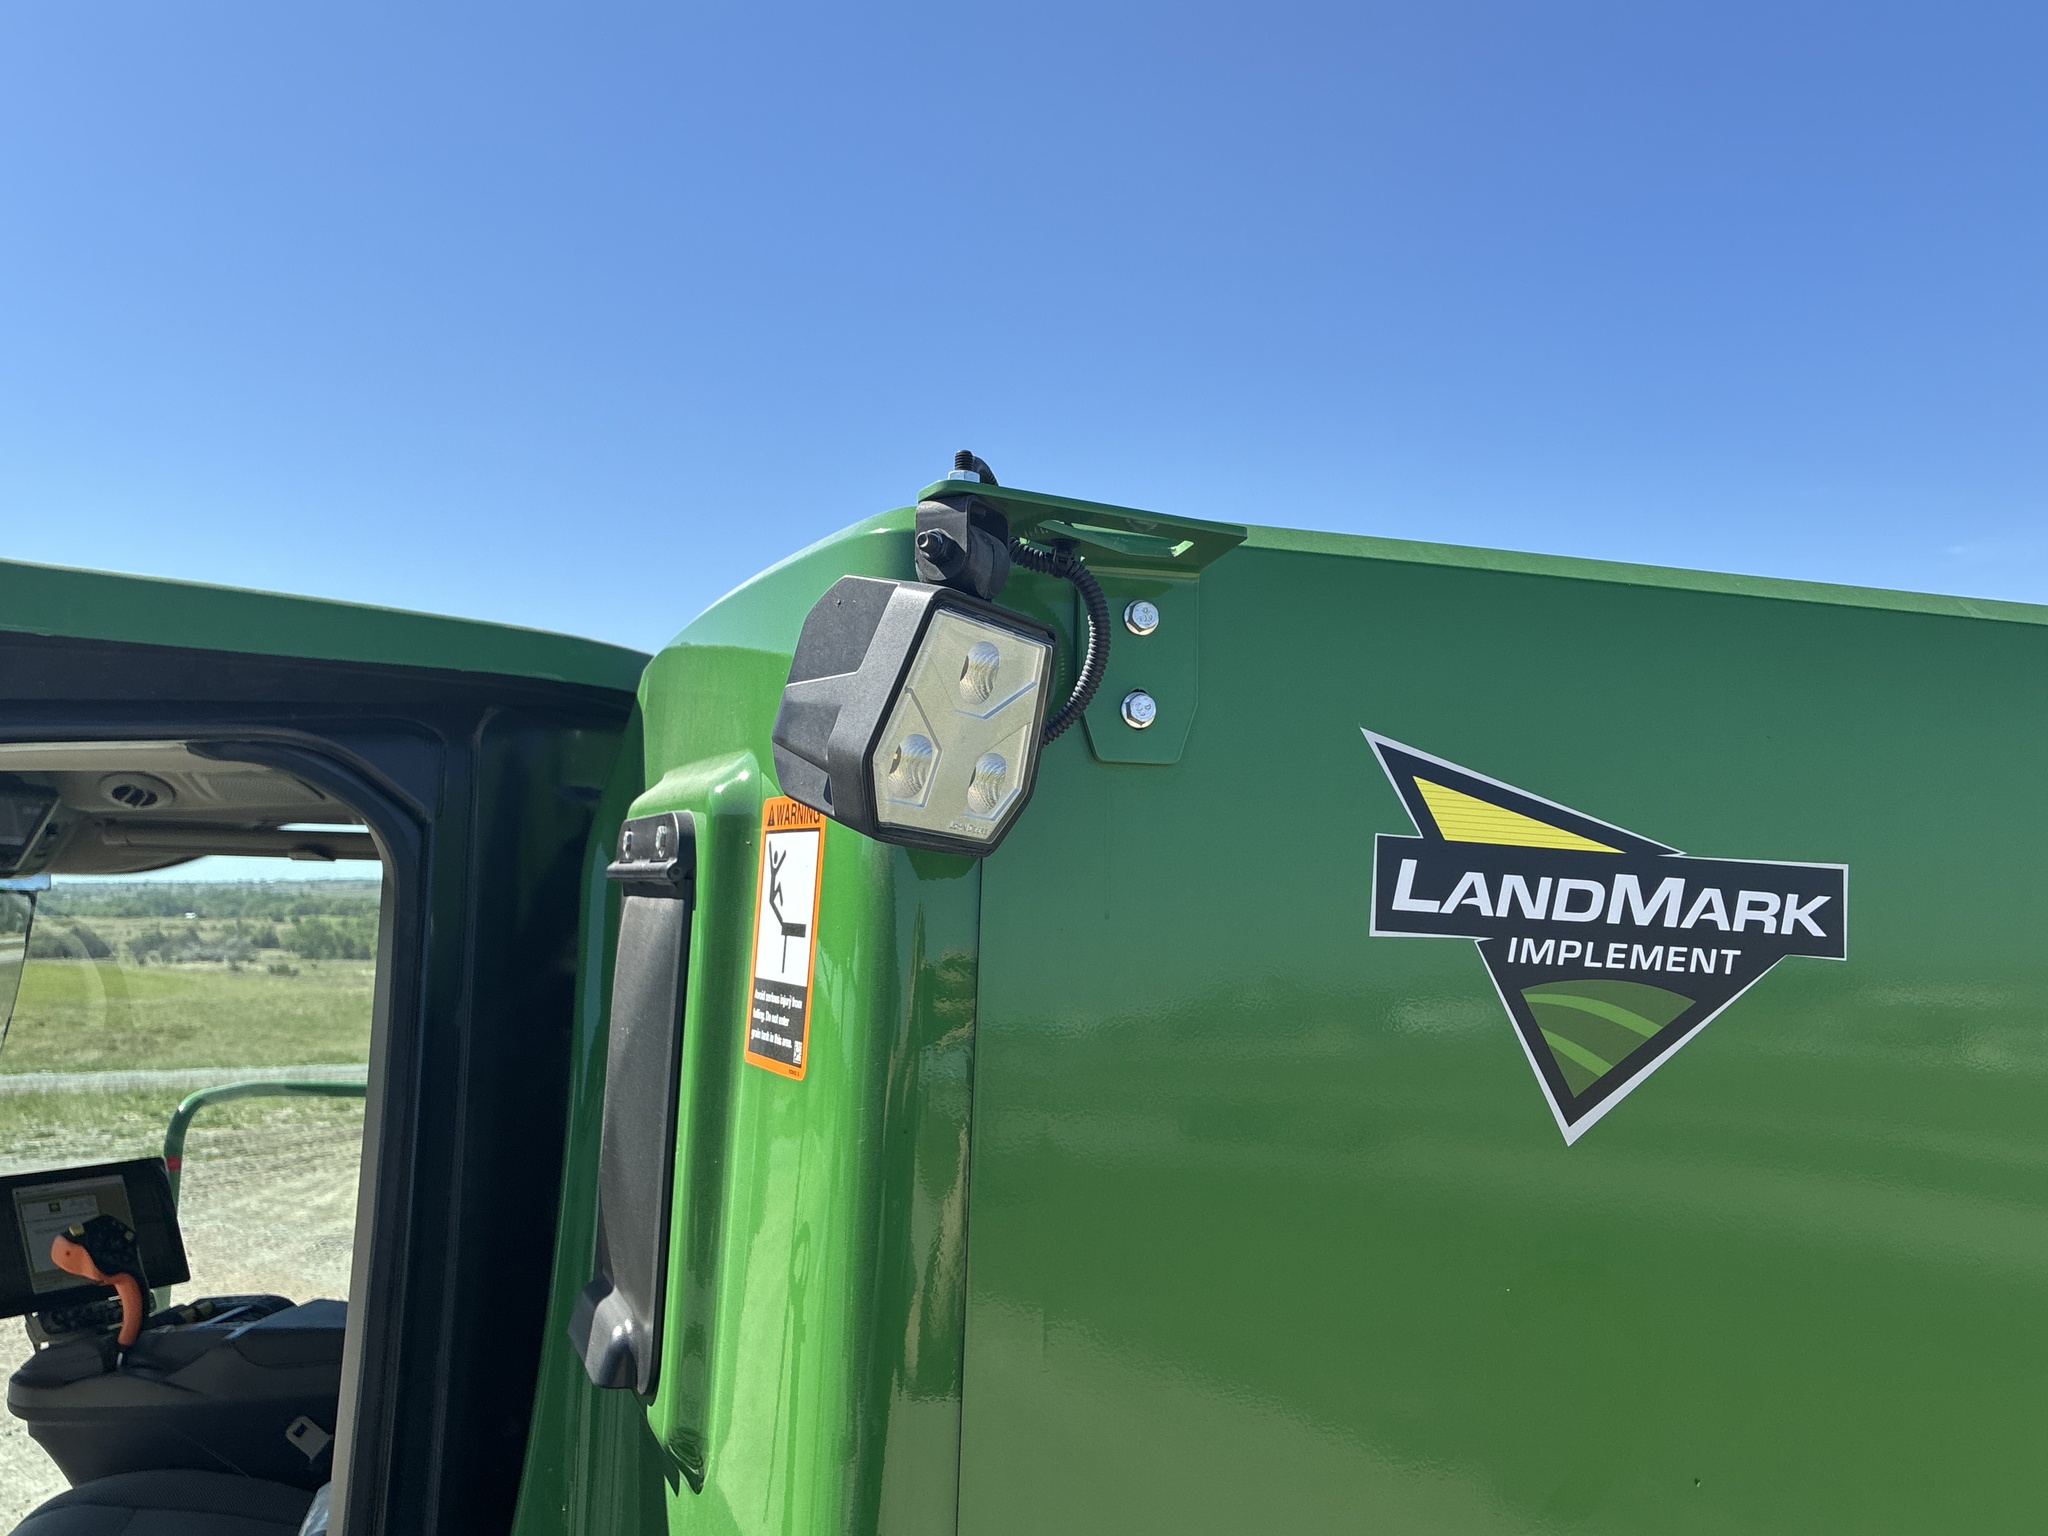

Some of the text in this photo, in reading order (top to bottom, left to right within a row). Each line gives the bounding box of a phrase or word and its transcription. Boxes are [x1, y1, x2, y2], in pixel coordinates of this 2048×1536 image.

[777, 803, 821, 825] WARNING
[1507, 937, 1741, 975] IMPLEMENT
[780, 994, 792, 1009] injury
